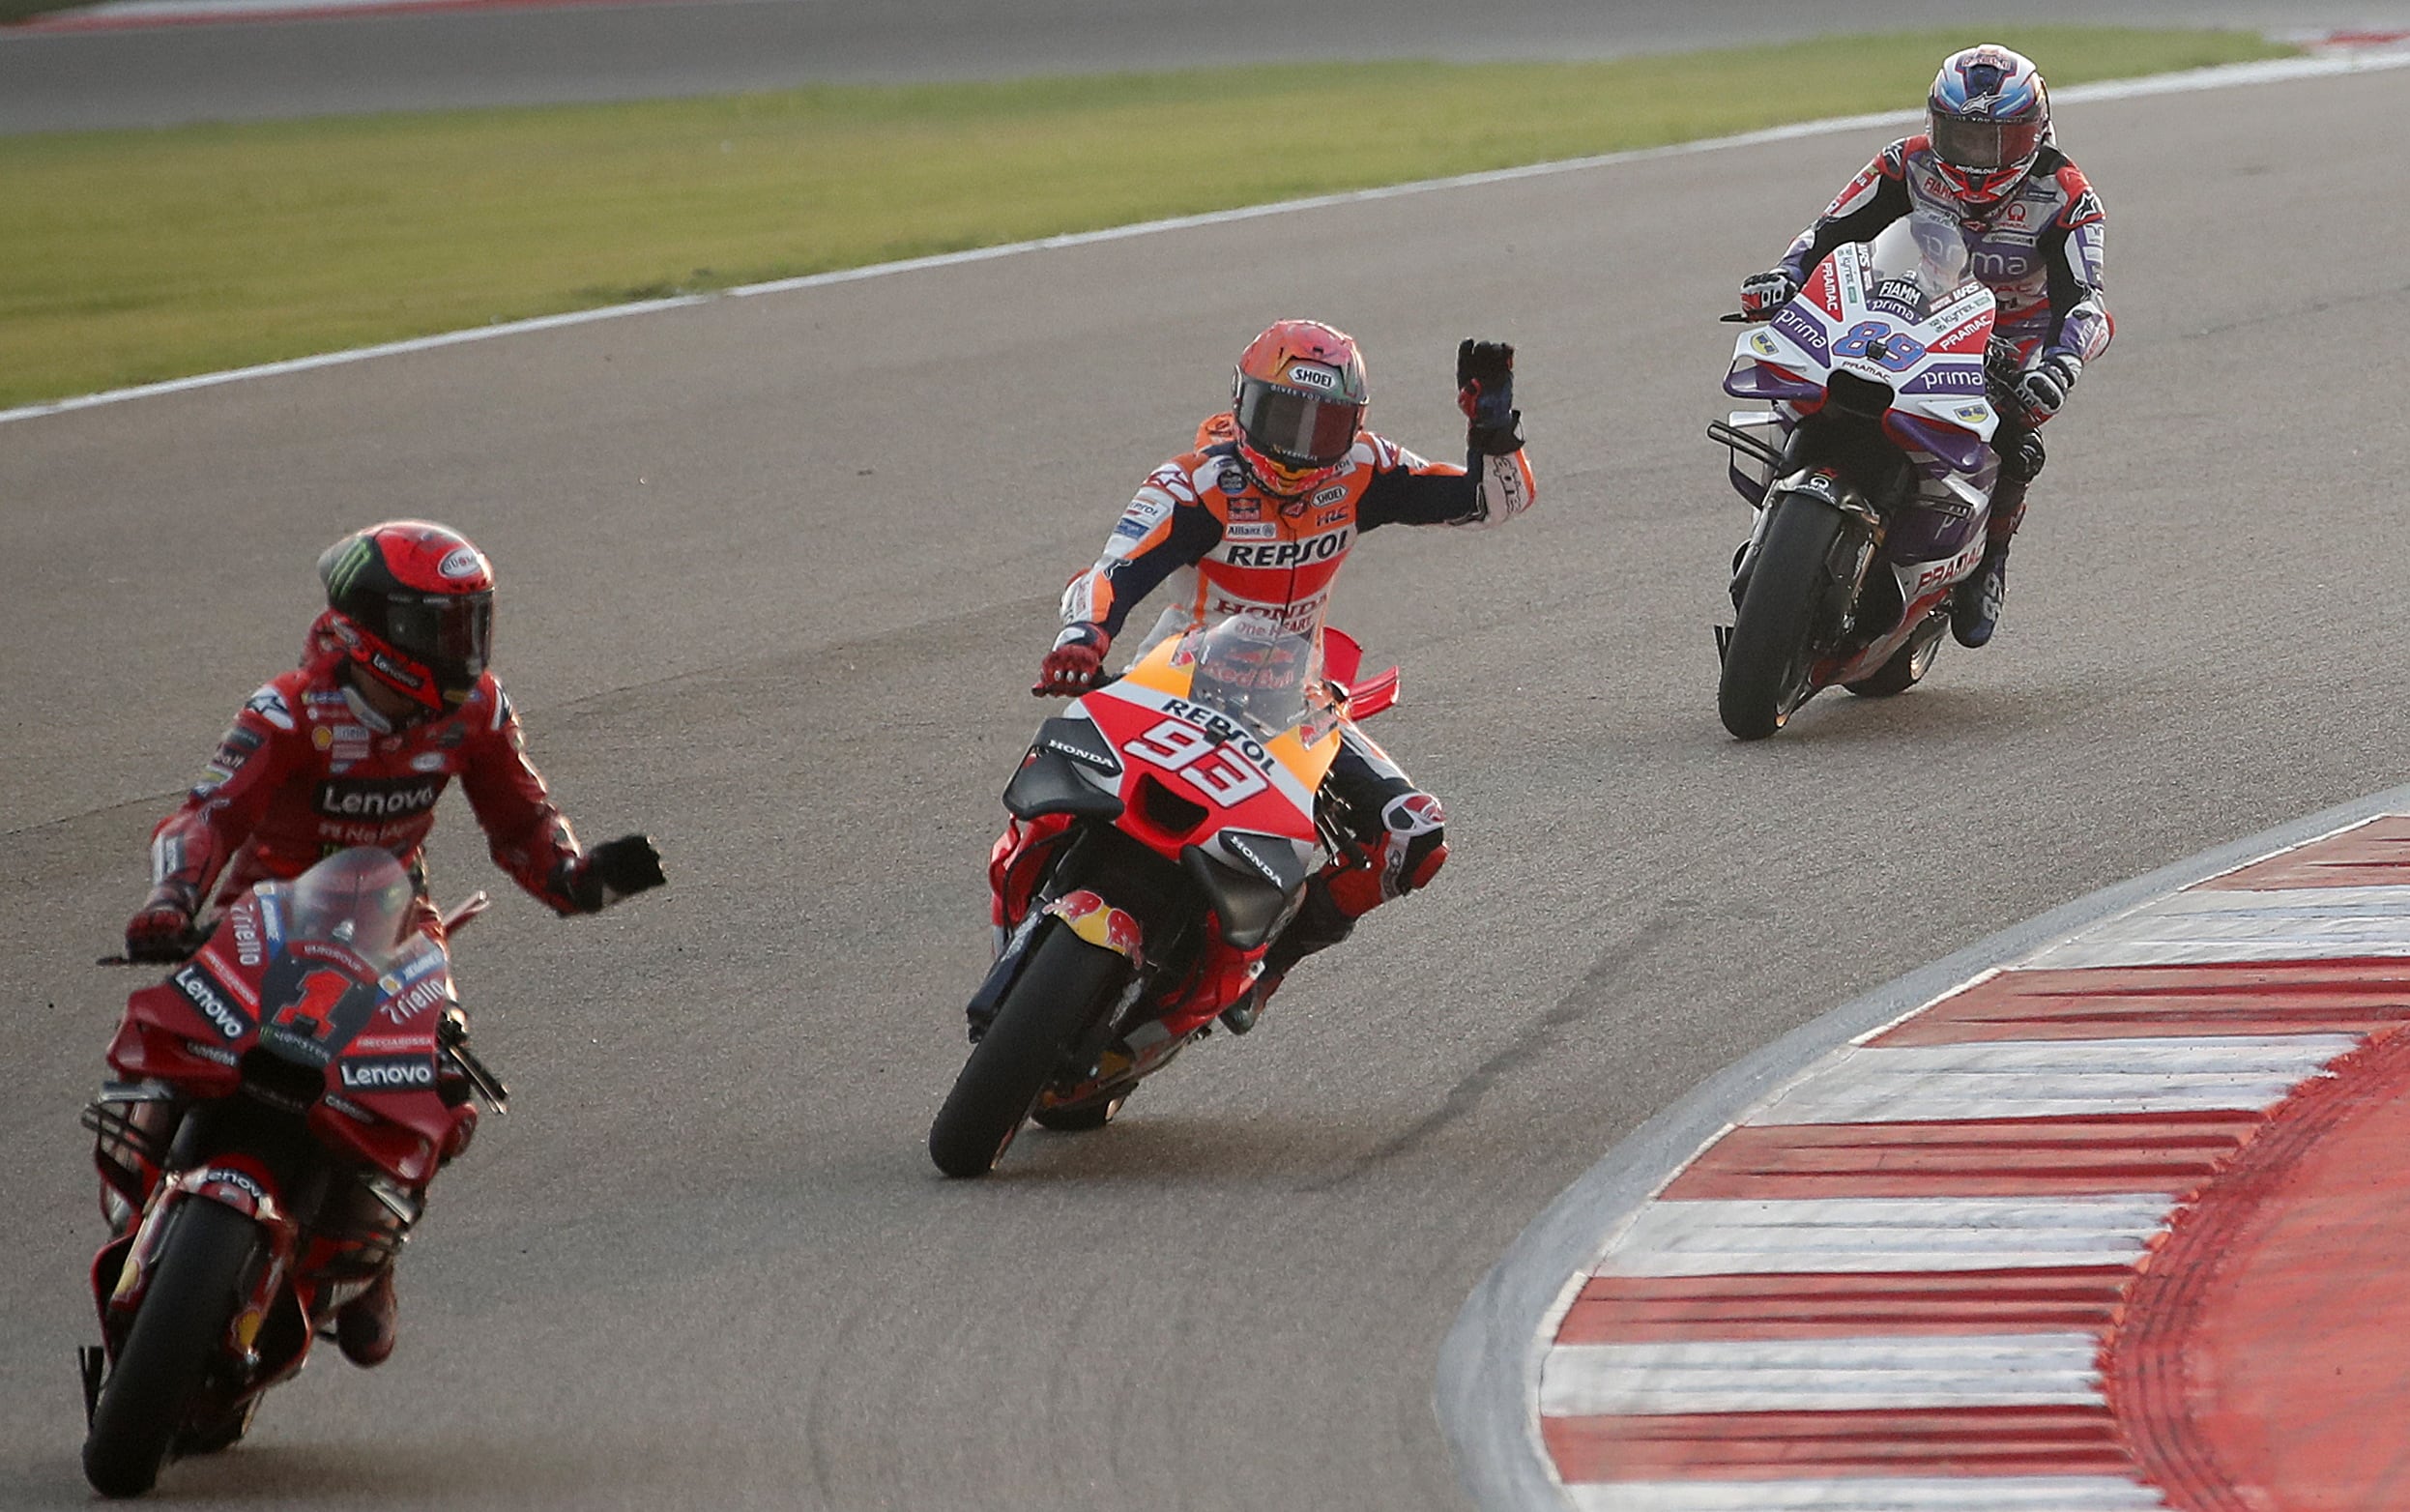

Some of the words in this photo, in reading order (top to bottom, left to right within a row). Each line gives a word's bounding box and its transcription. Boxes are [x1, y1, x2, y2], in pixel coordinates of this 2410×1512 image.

[1821, 262, 1839, 311] PRAMAC
[1878, 281, 1921, 305] FIAMM
[1873, 299, 1914, 320] prima
[1775, 309, 1827, 349] prima
[1831, 321, 1927, 372] 89
[1939, 315, 1991, 351] PRAMAC
[1295, 368, 1332, 388] SHOEI
[1842, 361, 1892, 383] PRAMAC
[1920, 371, 1983, 389] prima
[1317, 489, 1342, 504] SHOEI
[1226, 530, 1347, 567] REPSOL
[1049, 739, 1115, 769] HONDA
[1162, 699, 1276, 776] REPSOL
[1121, 715, 1269, 810] 93
[323, 786, 432, 815] Lenovo
[1230, 834, 1283, 888] HONDA
[175, 967, 242, 1038] Lenovo
[272, 969, 353, 1042] 1
[340, 1064, 430, 1085] Lenovo
